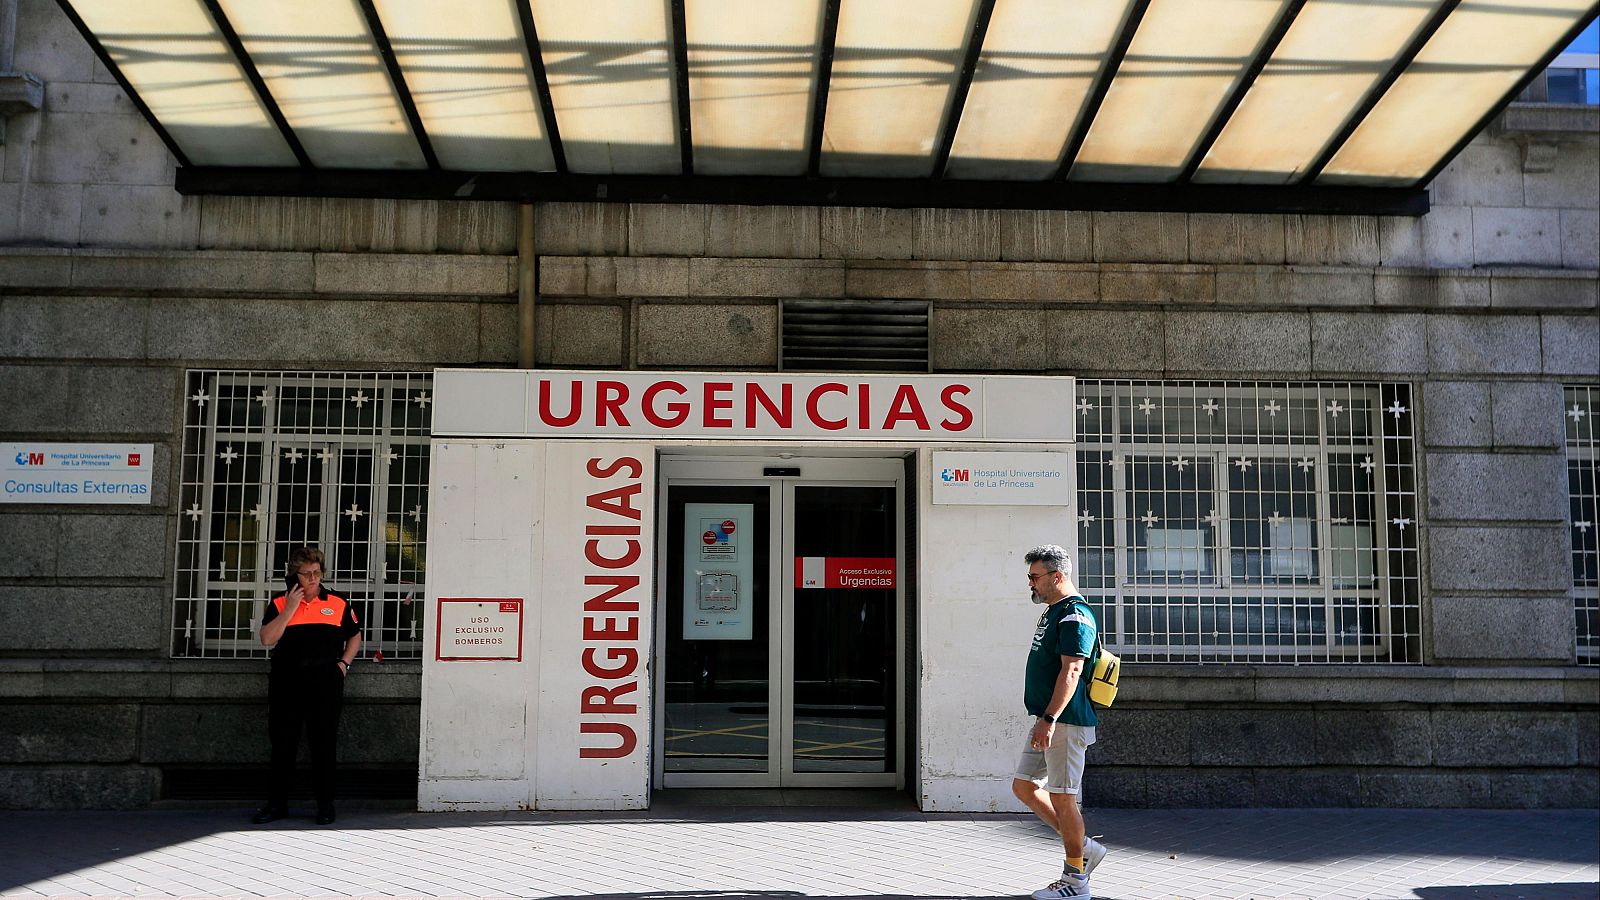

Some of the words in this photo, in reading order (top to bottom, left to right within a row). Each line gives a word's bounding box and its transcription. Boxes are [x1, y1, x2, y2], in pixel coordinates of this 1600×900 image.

[540, 380, 973, 430] URGENCIAS
[974, 469, 1008, 478] Hospital
[1009, 469, 1060, 478] Universitario
[4, 479, 78, 494] Consultas
[83, 480, 147, 495] Externas
[974, 480, 985, 488] de
[986, 480, 997, 488] La
[999, 480, 1035, 488] Princesa
[840, 576, 892, 587] Urgencias
[581, 457, 642, 757] URGENCIAS
